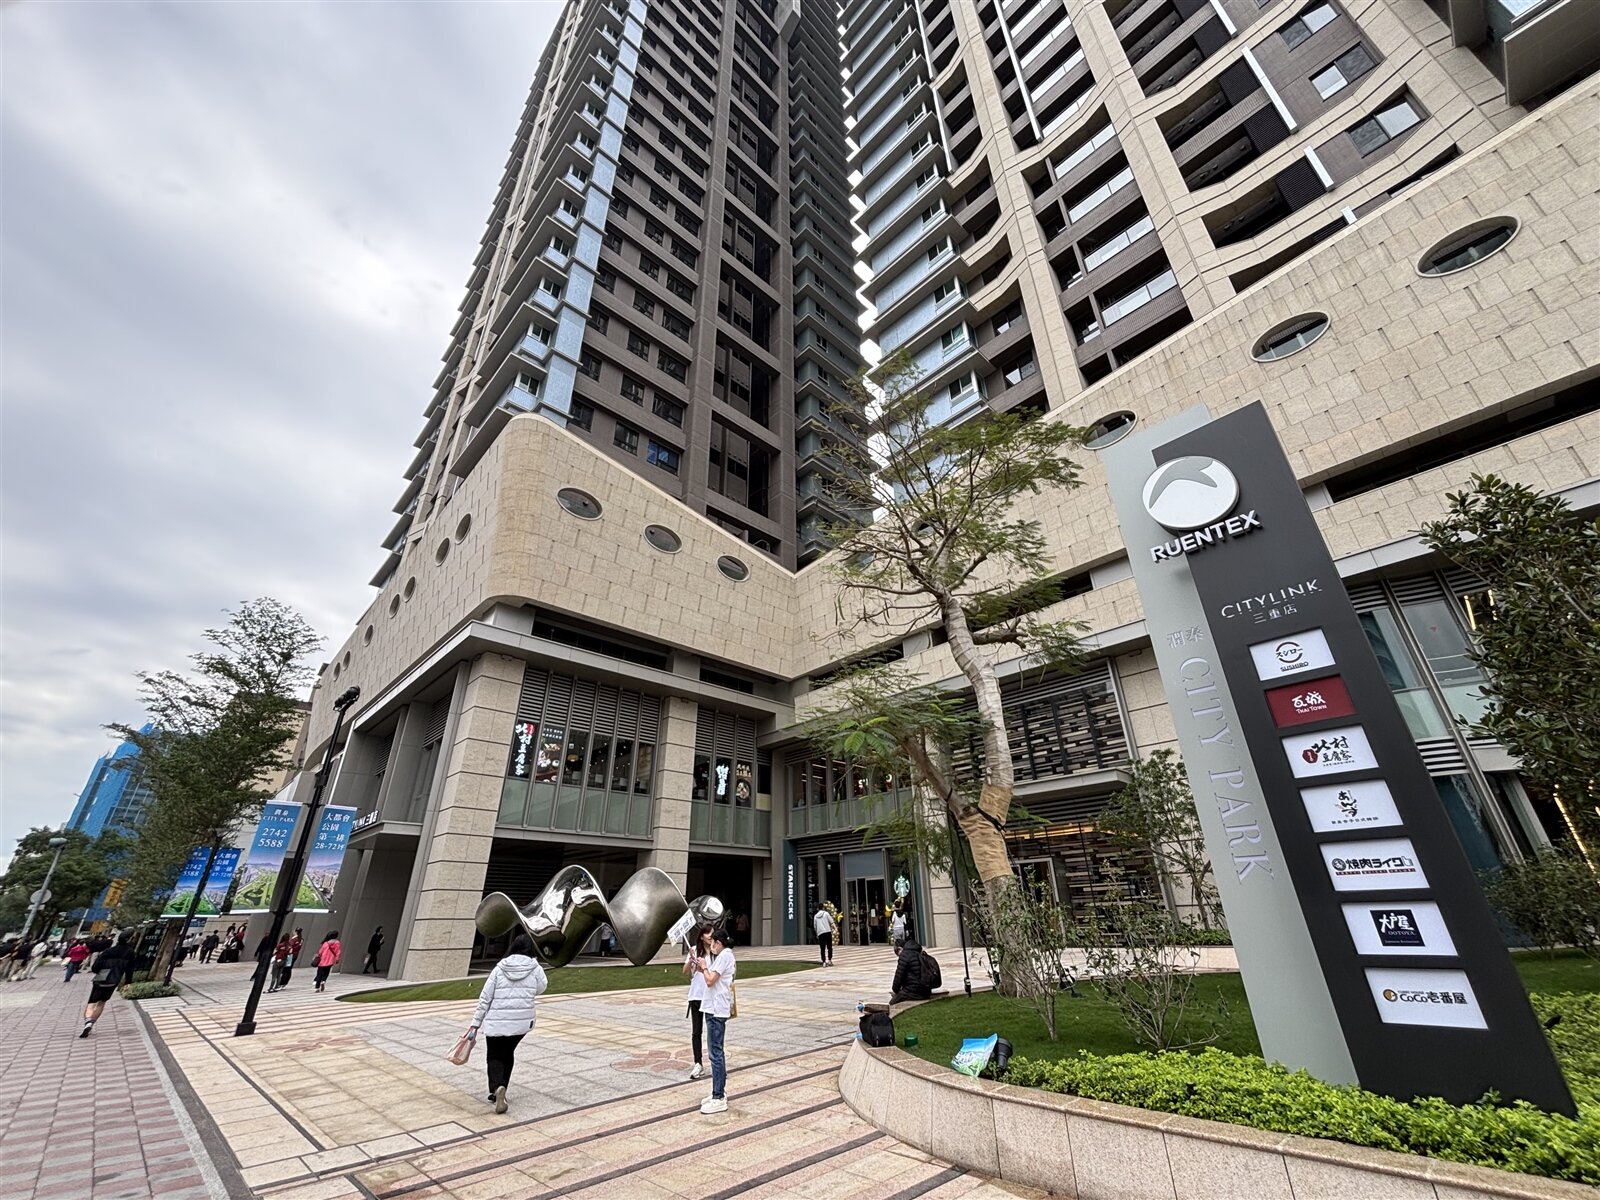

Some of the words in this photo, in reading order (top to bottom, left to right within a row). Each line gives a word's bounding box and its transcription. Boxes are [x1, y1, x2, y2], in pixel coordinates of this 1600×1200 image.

[1150, 510, 1260, 562] RUENTEX
[1221, 579, 1323, 619] CITYLINK
[1253, 604, 1298, 624] 三重店
[1275, 648, 1303, 658] スシロー
[1292, 691, 1326, 708] 瓦城
[1311, 736, 1349, 753] 北村
[1322, 750, 1352, 763] 豆腐家
[1179, 656, 1234, 748] CITY
[1208, 765, 1276, 885] PARK
[325, 812, 351, 823] 大都會
[262, 827, 288, 837] 2742
[321, 823, 340, 831] 公園
[257, 838, 284, 848] 5588
